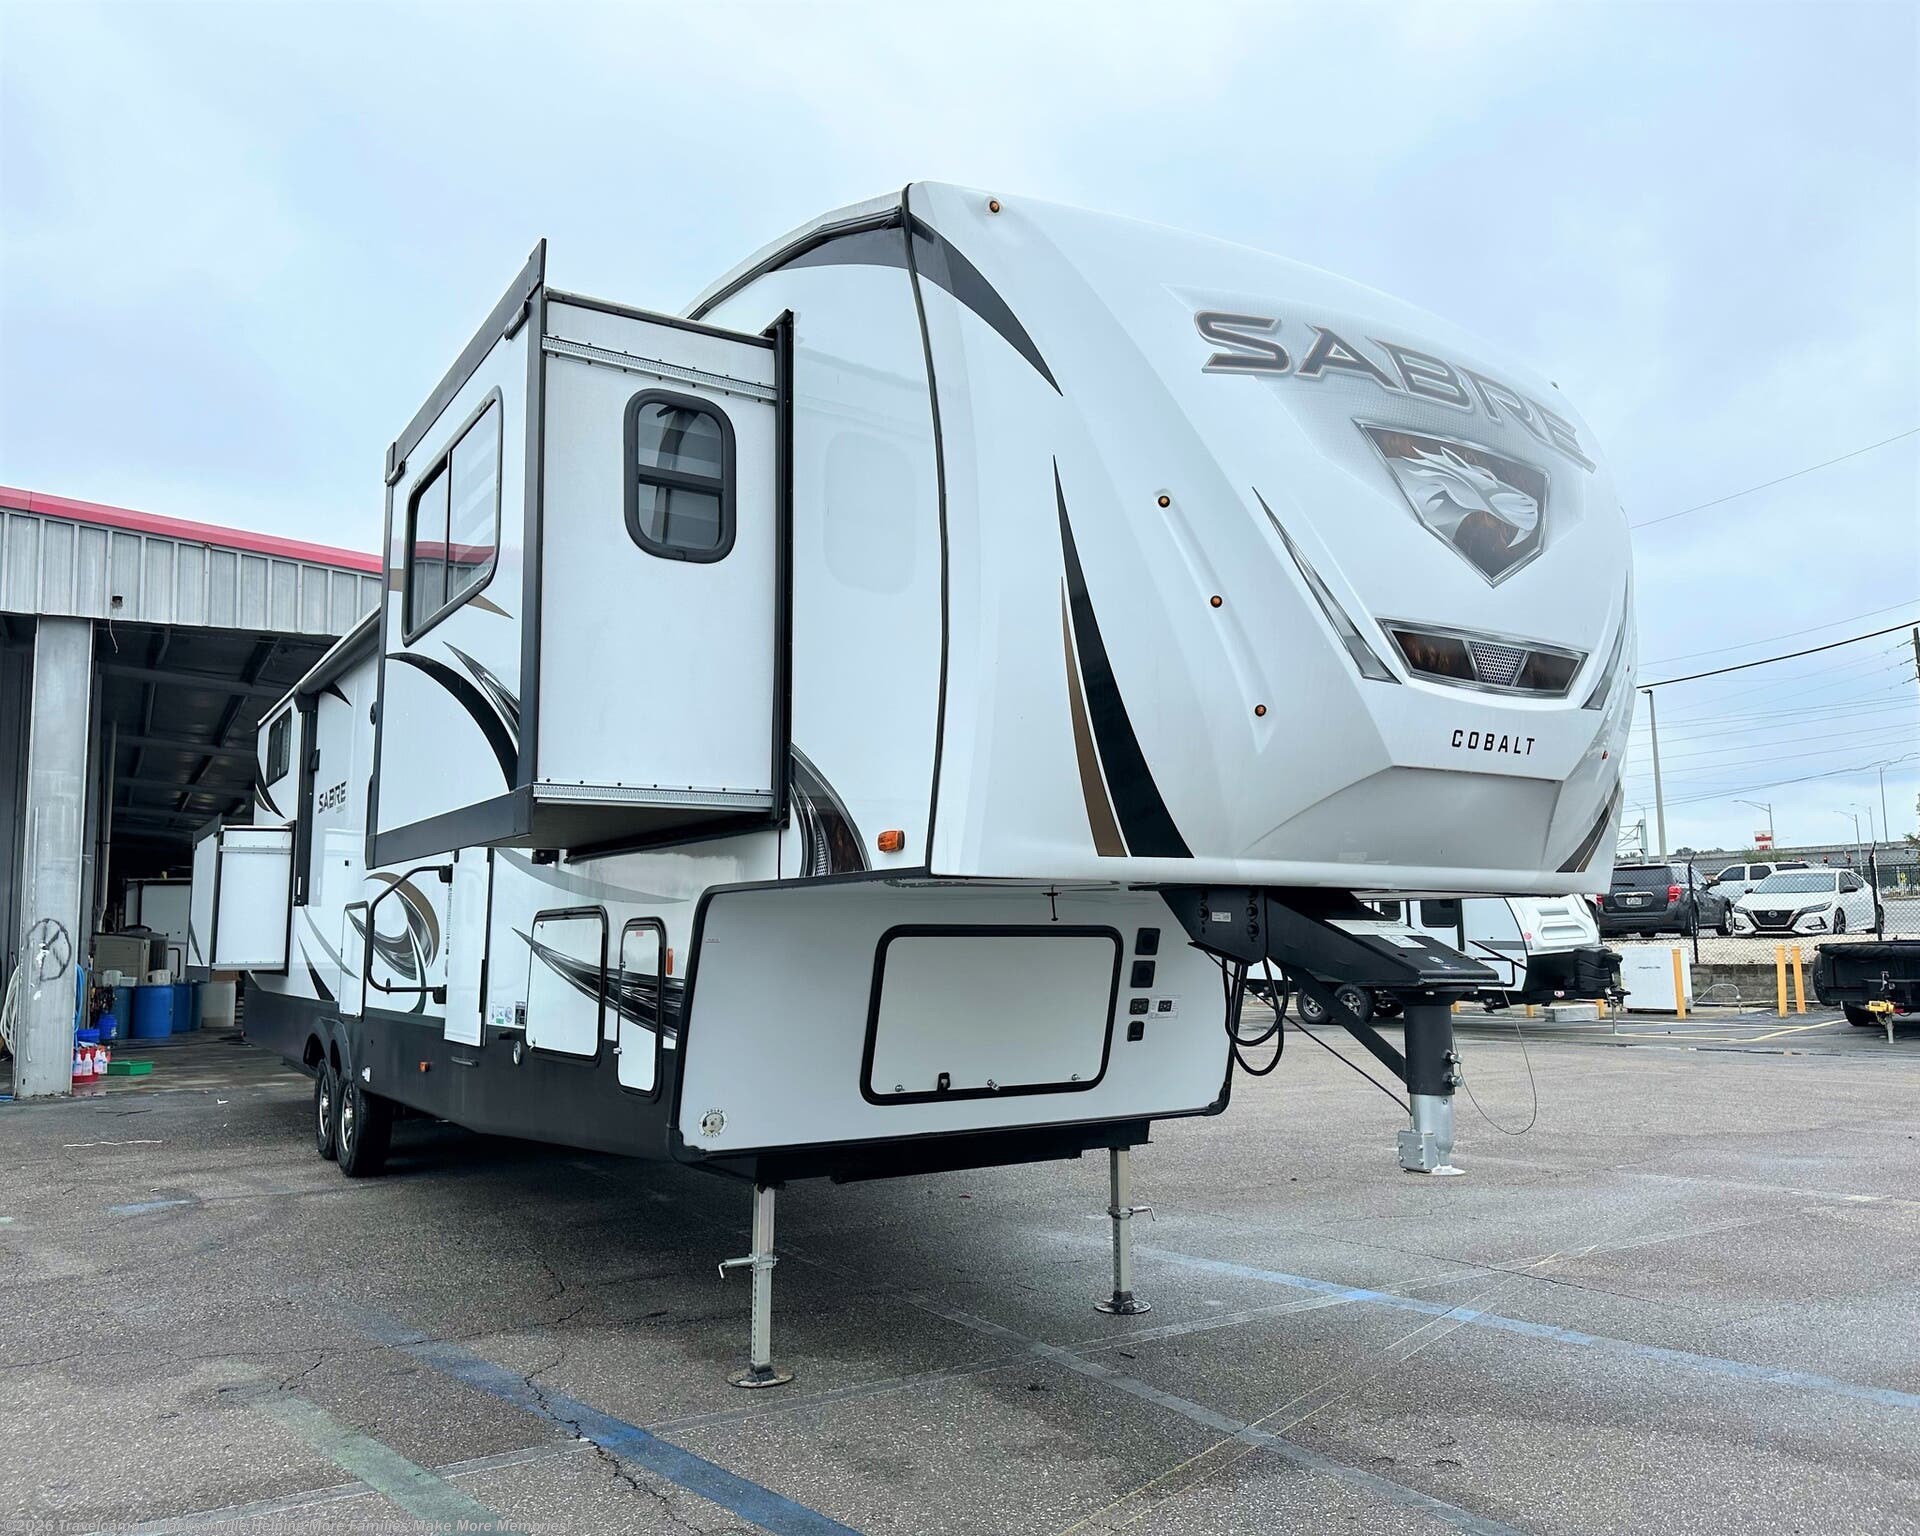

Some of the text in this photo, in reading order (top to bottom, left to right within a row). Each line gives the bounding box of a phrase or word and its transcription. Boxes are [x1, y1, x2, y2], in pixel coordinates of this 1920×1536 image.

[1194, 311, 1596, 474] SABRE
[1451, 729, 1535, 755] COBALT
[318, 780, 347, 814] SABRE
